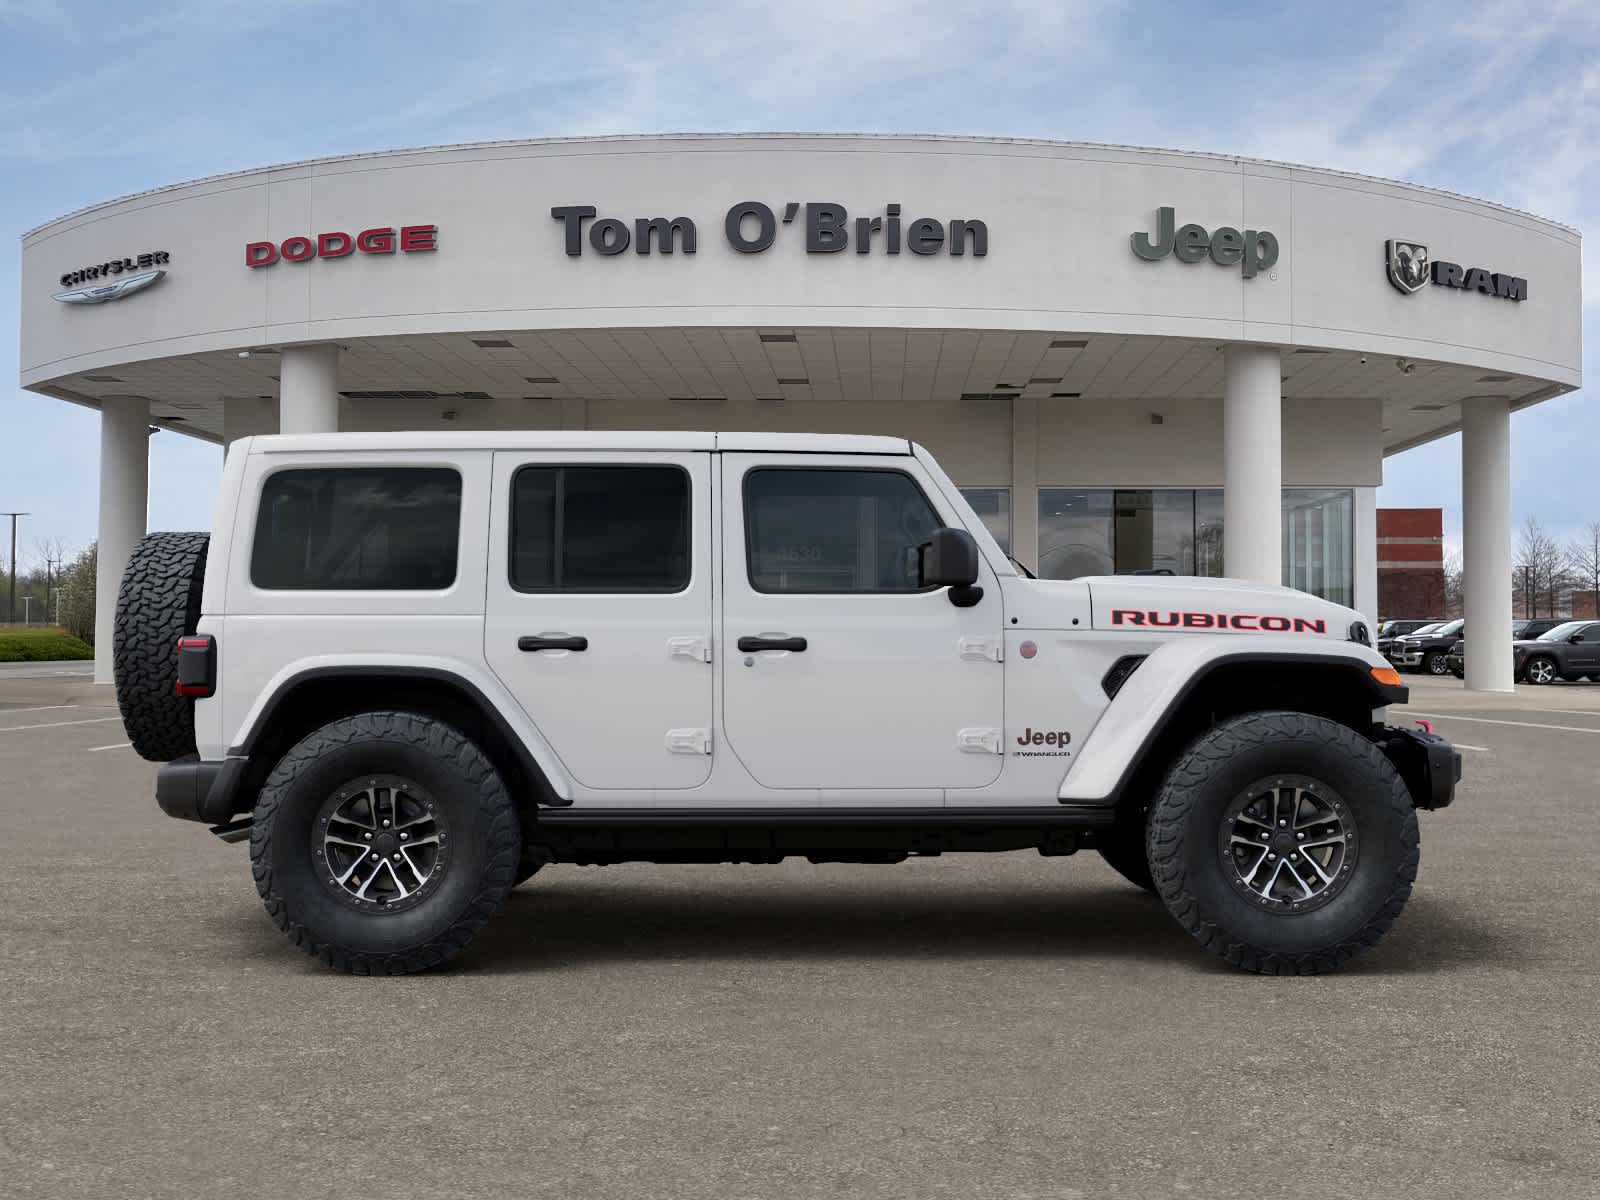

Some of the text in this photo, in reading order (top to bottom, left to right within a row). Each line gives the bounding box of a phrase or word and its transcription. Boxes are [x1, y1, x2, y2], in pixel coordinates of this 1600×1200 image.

[245, 225, 438, 269] DODGE
[551, 201, 988, 257] Tom O'Brien
[1130, 206, 1279, 279] Jeep
[60, 250, 170, 287] CHRYSLER
[1430, 260, 1528, 302] RAM
[1110, 609, 1327, 634] RUBICON
[1016, 727, 1071, 749] Jeep
